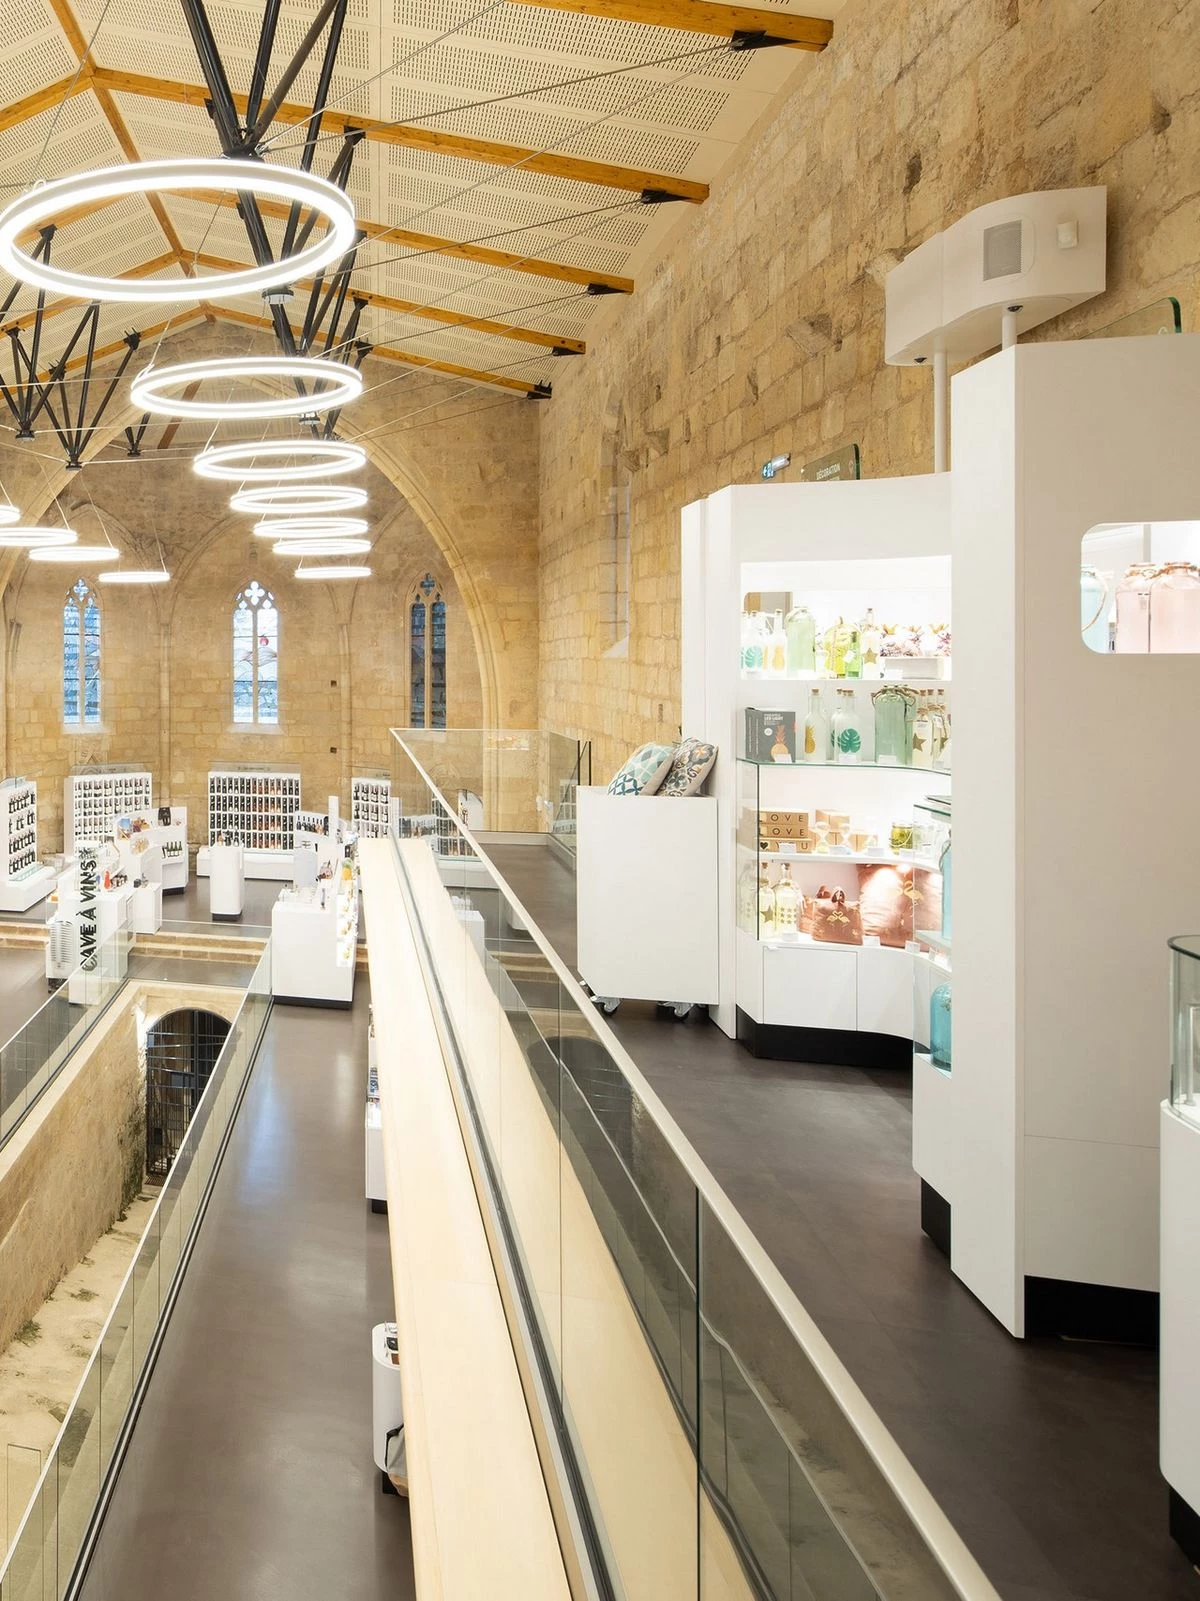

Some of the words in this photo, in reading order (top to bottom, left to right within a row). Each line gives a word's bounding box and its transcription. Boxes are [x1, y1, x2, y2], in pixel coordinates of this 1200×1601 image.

[80, 859, 98, 903] VINS
[76, 907, 97, 921] À
[80, 924, 98, 972] CAVE
